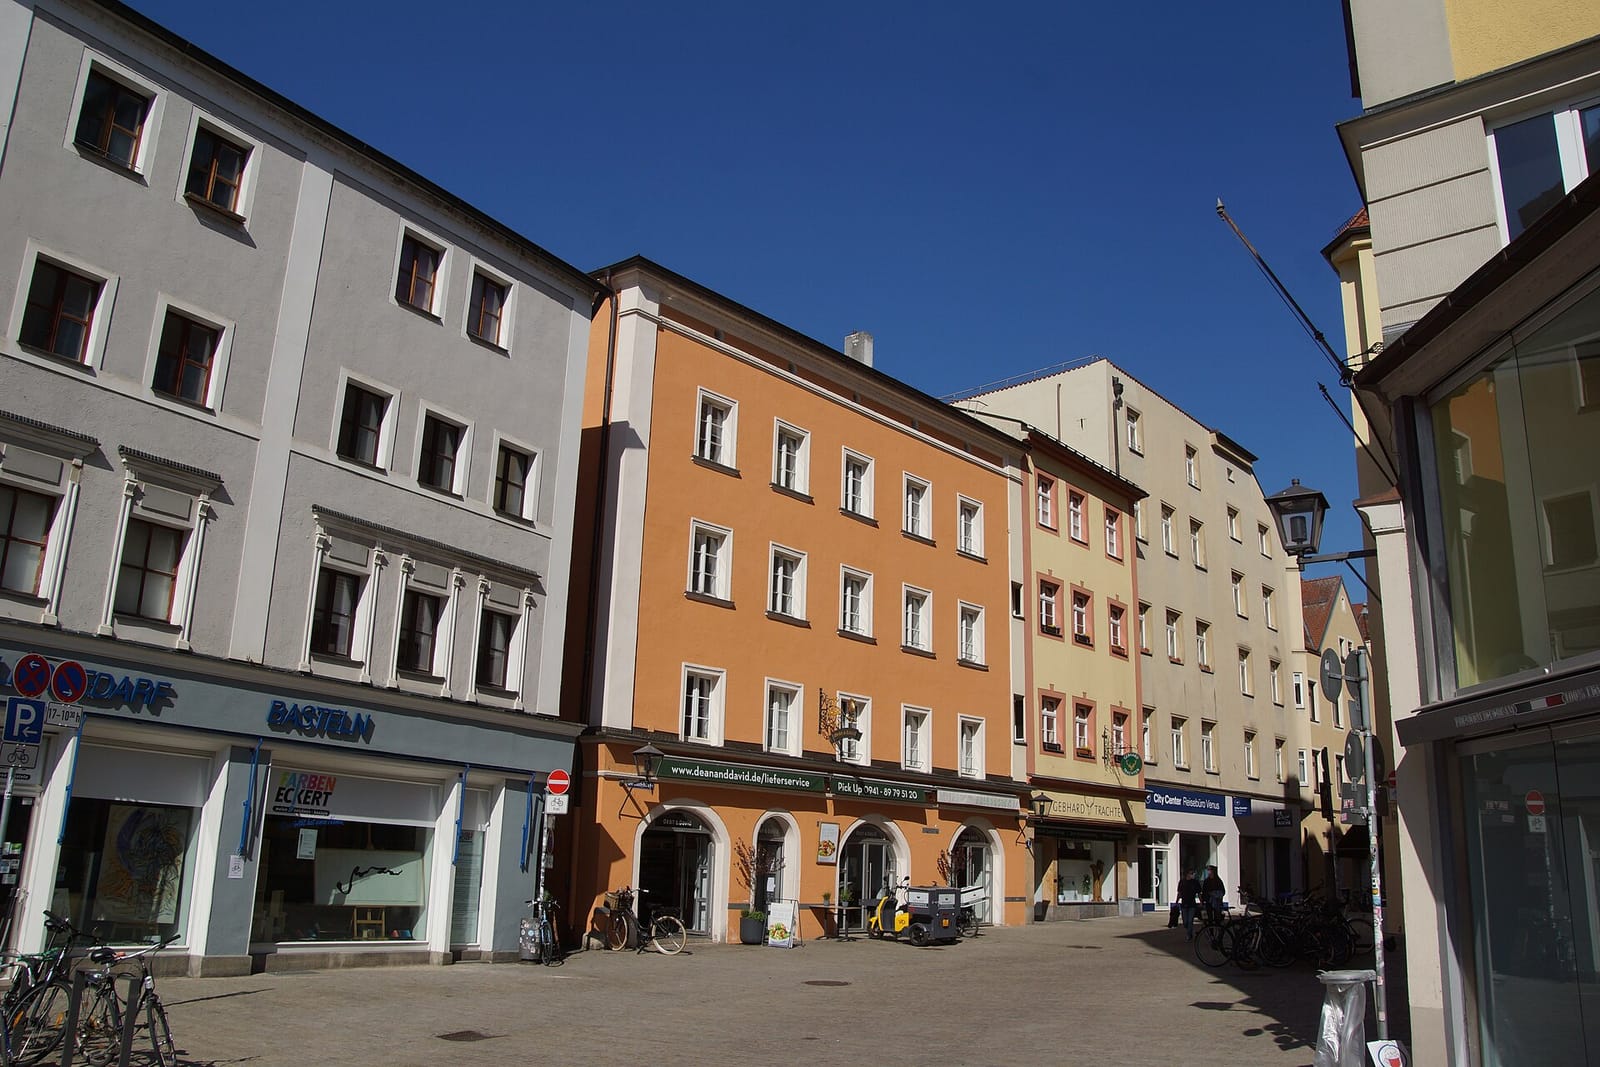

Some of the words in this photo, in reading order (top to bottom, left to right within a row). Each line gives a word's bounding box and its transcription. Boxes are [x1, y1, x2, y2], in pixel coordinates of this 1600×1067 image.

[13, 704, 36, 737] P
[267, 700, 371, 736] BASTELN
[281, 771, 337, 792] FARBEN
[671, 766, 810, 788] www.deananddavid.de/lieferservice
[275, 787, 333, 807] ECKERT
[837, 782, 852, 793] Pick
[852, 784, 863, 795] Up
[864, 785, 879, 796] 0941
[884, 787, 892, 797] 89
[892, 788, 901, 798] 79
[1052, 801, 1085, 815] GEBHARD
[1094, 805, 1122, 818] TRACHTE
[1153, 793, 1165, 806] City
[1165, 794, 1182, 806] Center
[1183, 796, 1206, 808] Reisebüro
[1206, 798, 1220, 810] Venus
